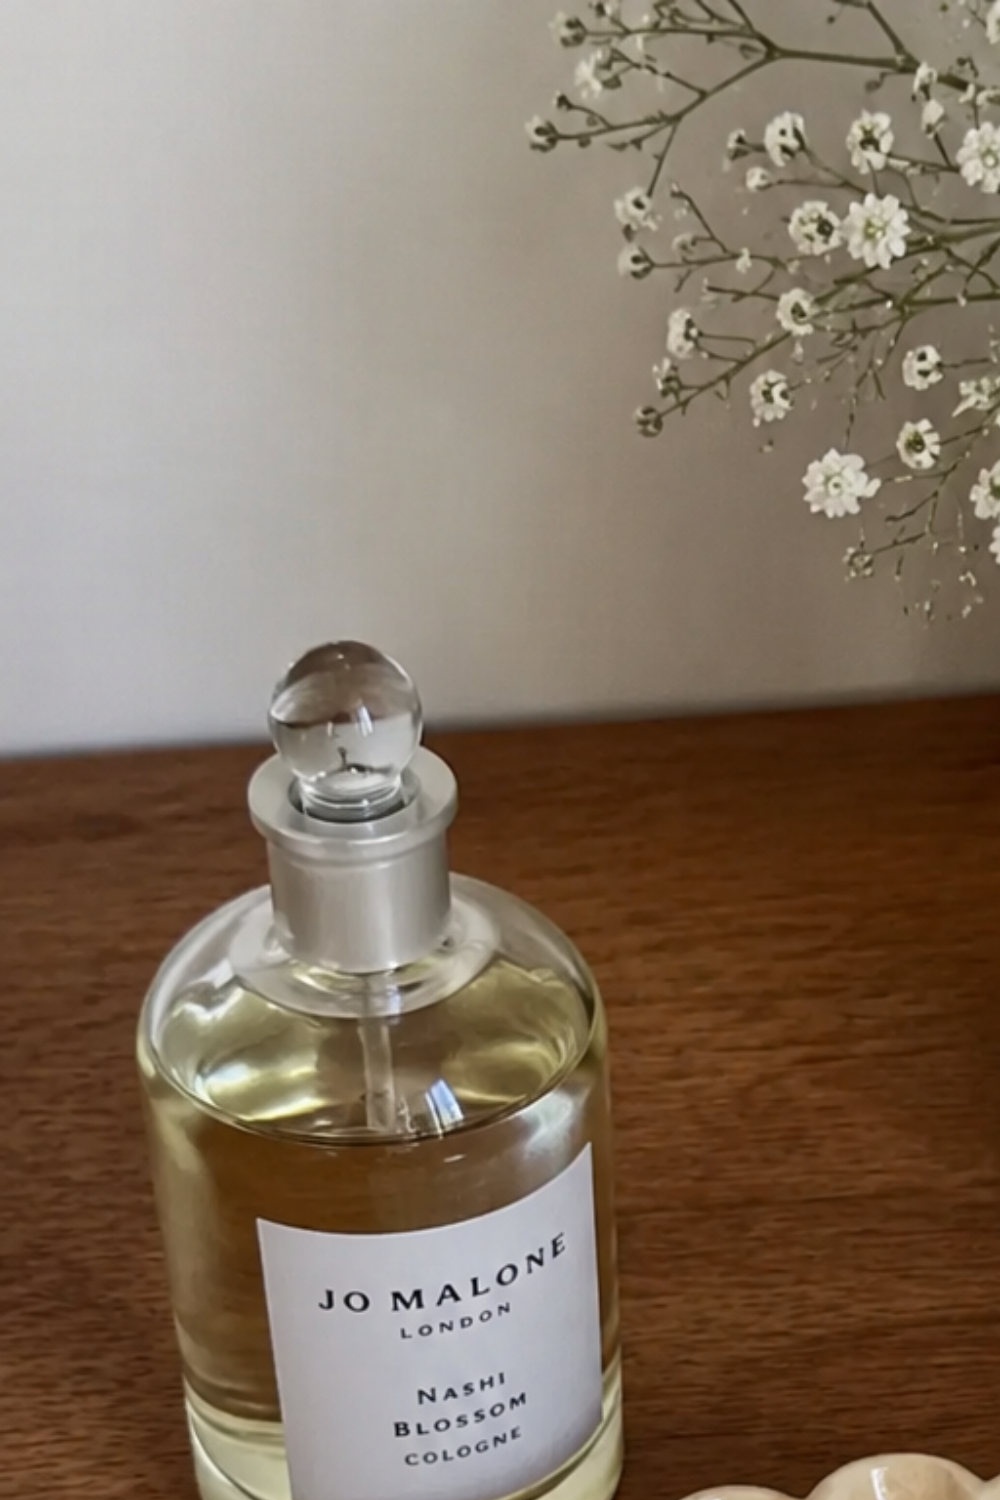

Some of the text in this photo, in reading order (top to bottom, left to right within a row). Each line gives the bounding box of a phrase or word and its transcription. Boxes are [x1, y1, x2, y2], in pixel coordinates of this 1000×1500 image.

[318, 1232, 567, 1313] JO MALONE
[400, 1302, 511, 1340] LONDON
[394, 1392, 526, 1437] BLOSSOM
[404, 1426, 522, 1466] COLOGNE
